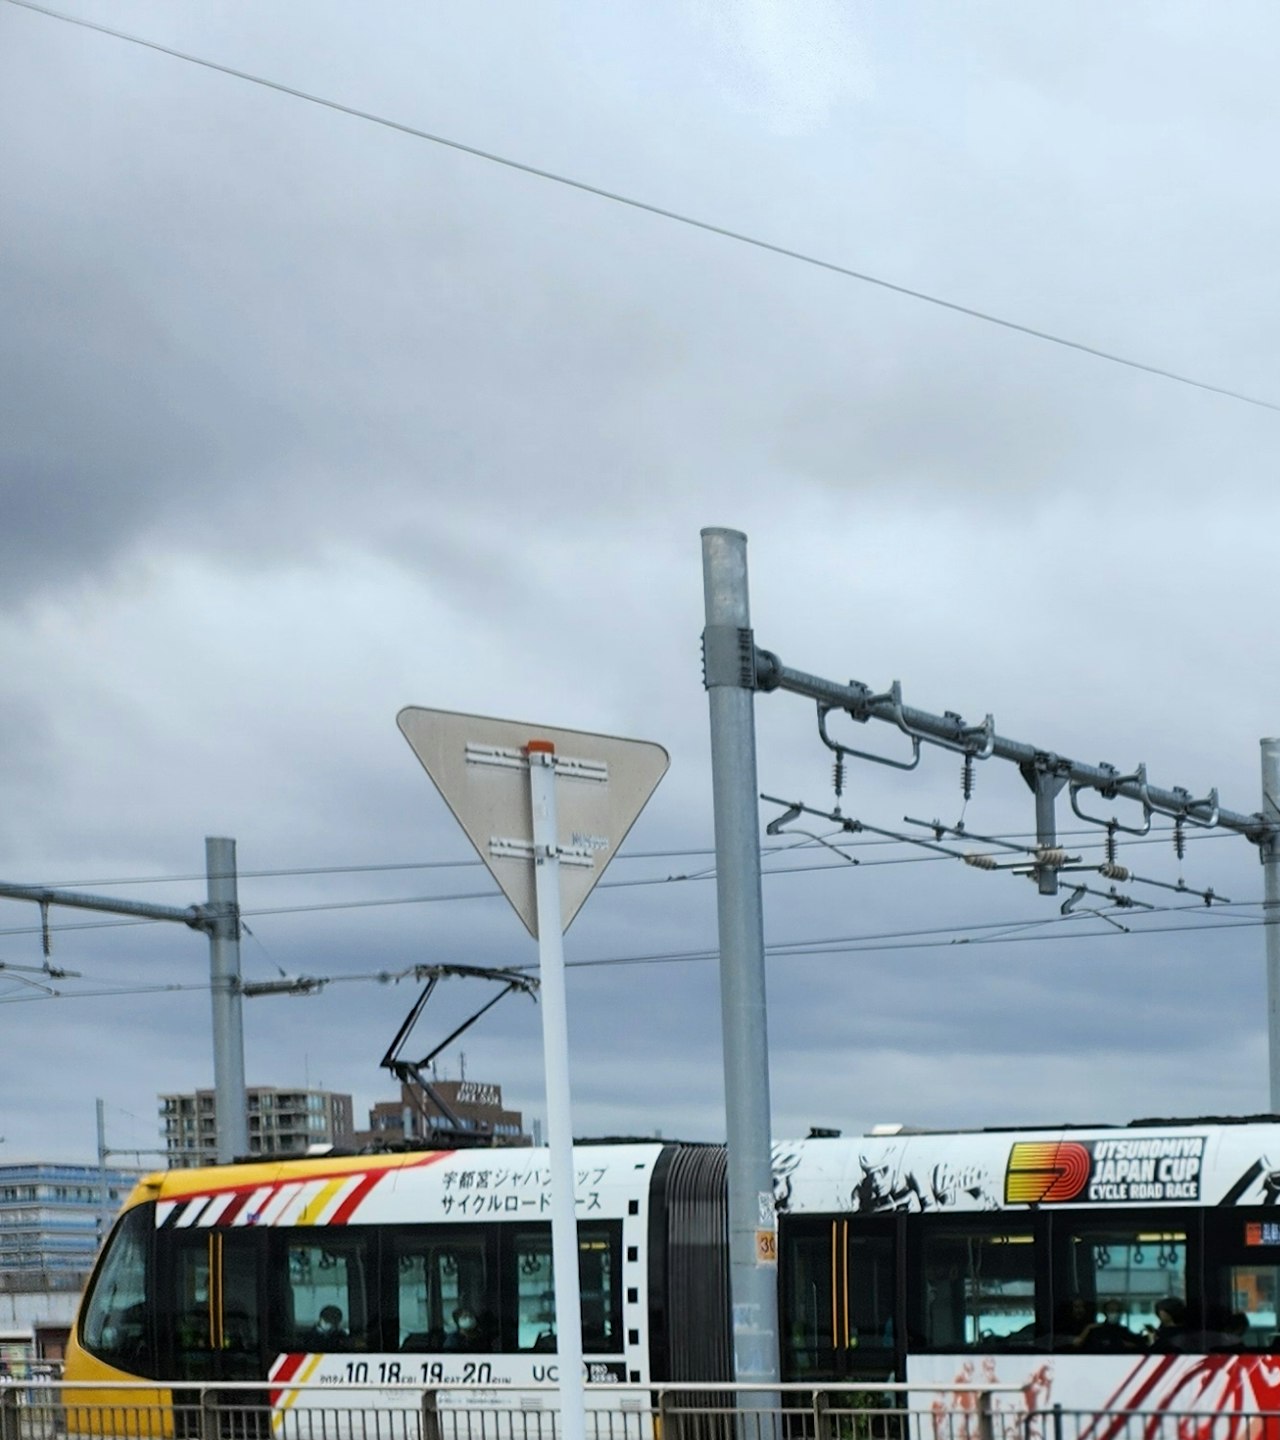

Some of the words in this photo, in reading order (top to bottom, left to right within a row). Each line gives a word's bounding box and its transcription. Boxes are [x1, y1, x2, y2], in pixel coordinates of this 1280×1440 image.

[1094, 1138, 1203, 1160] UTSUNOMIYA
[443, 1166, 610, 1191] 宇都宮ジャパンップ
[1092, 1159, 1157, 1184] JAPAN
[1157, 1157, 1200, 1182] CUP
[1089, 1184, 1128, 1200] CYCLE
[1130, 1184, 1163, 1199] ROAD
[1165, 1182, 1197, 1198] RACE
[442, 1192, 602, 1215] サイクルロードース
